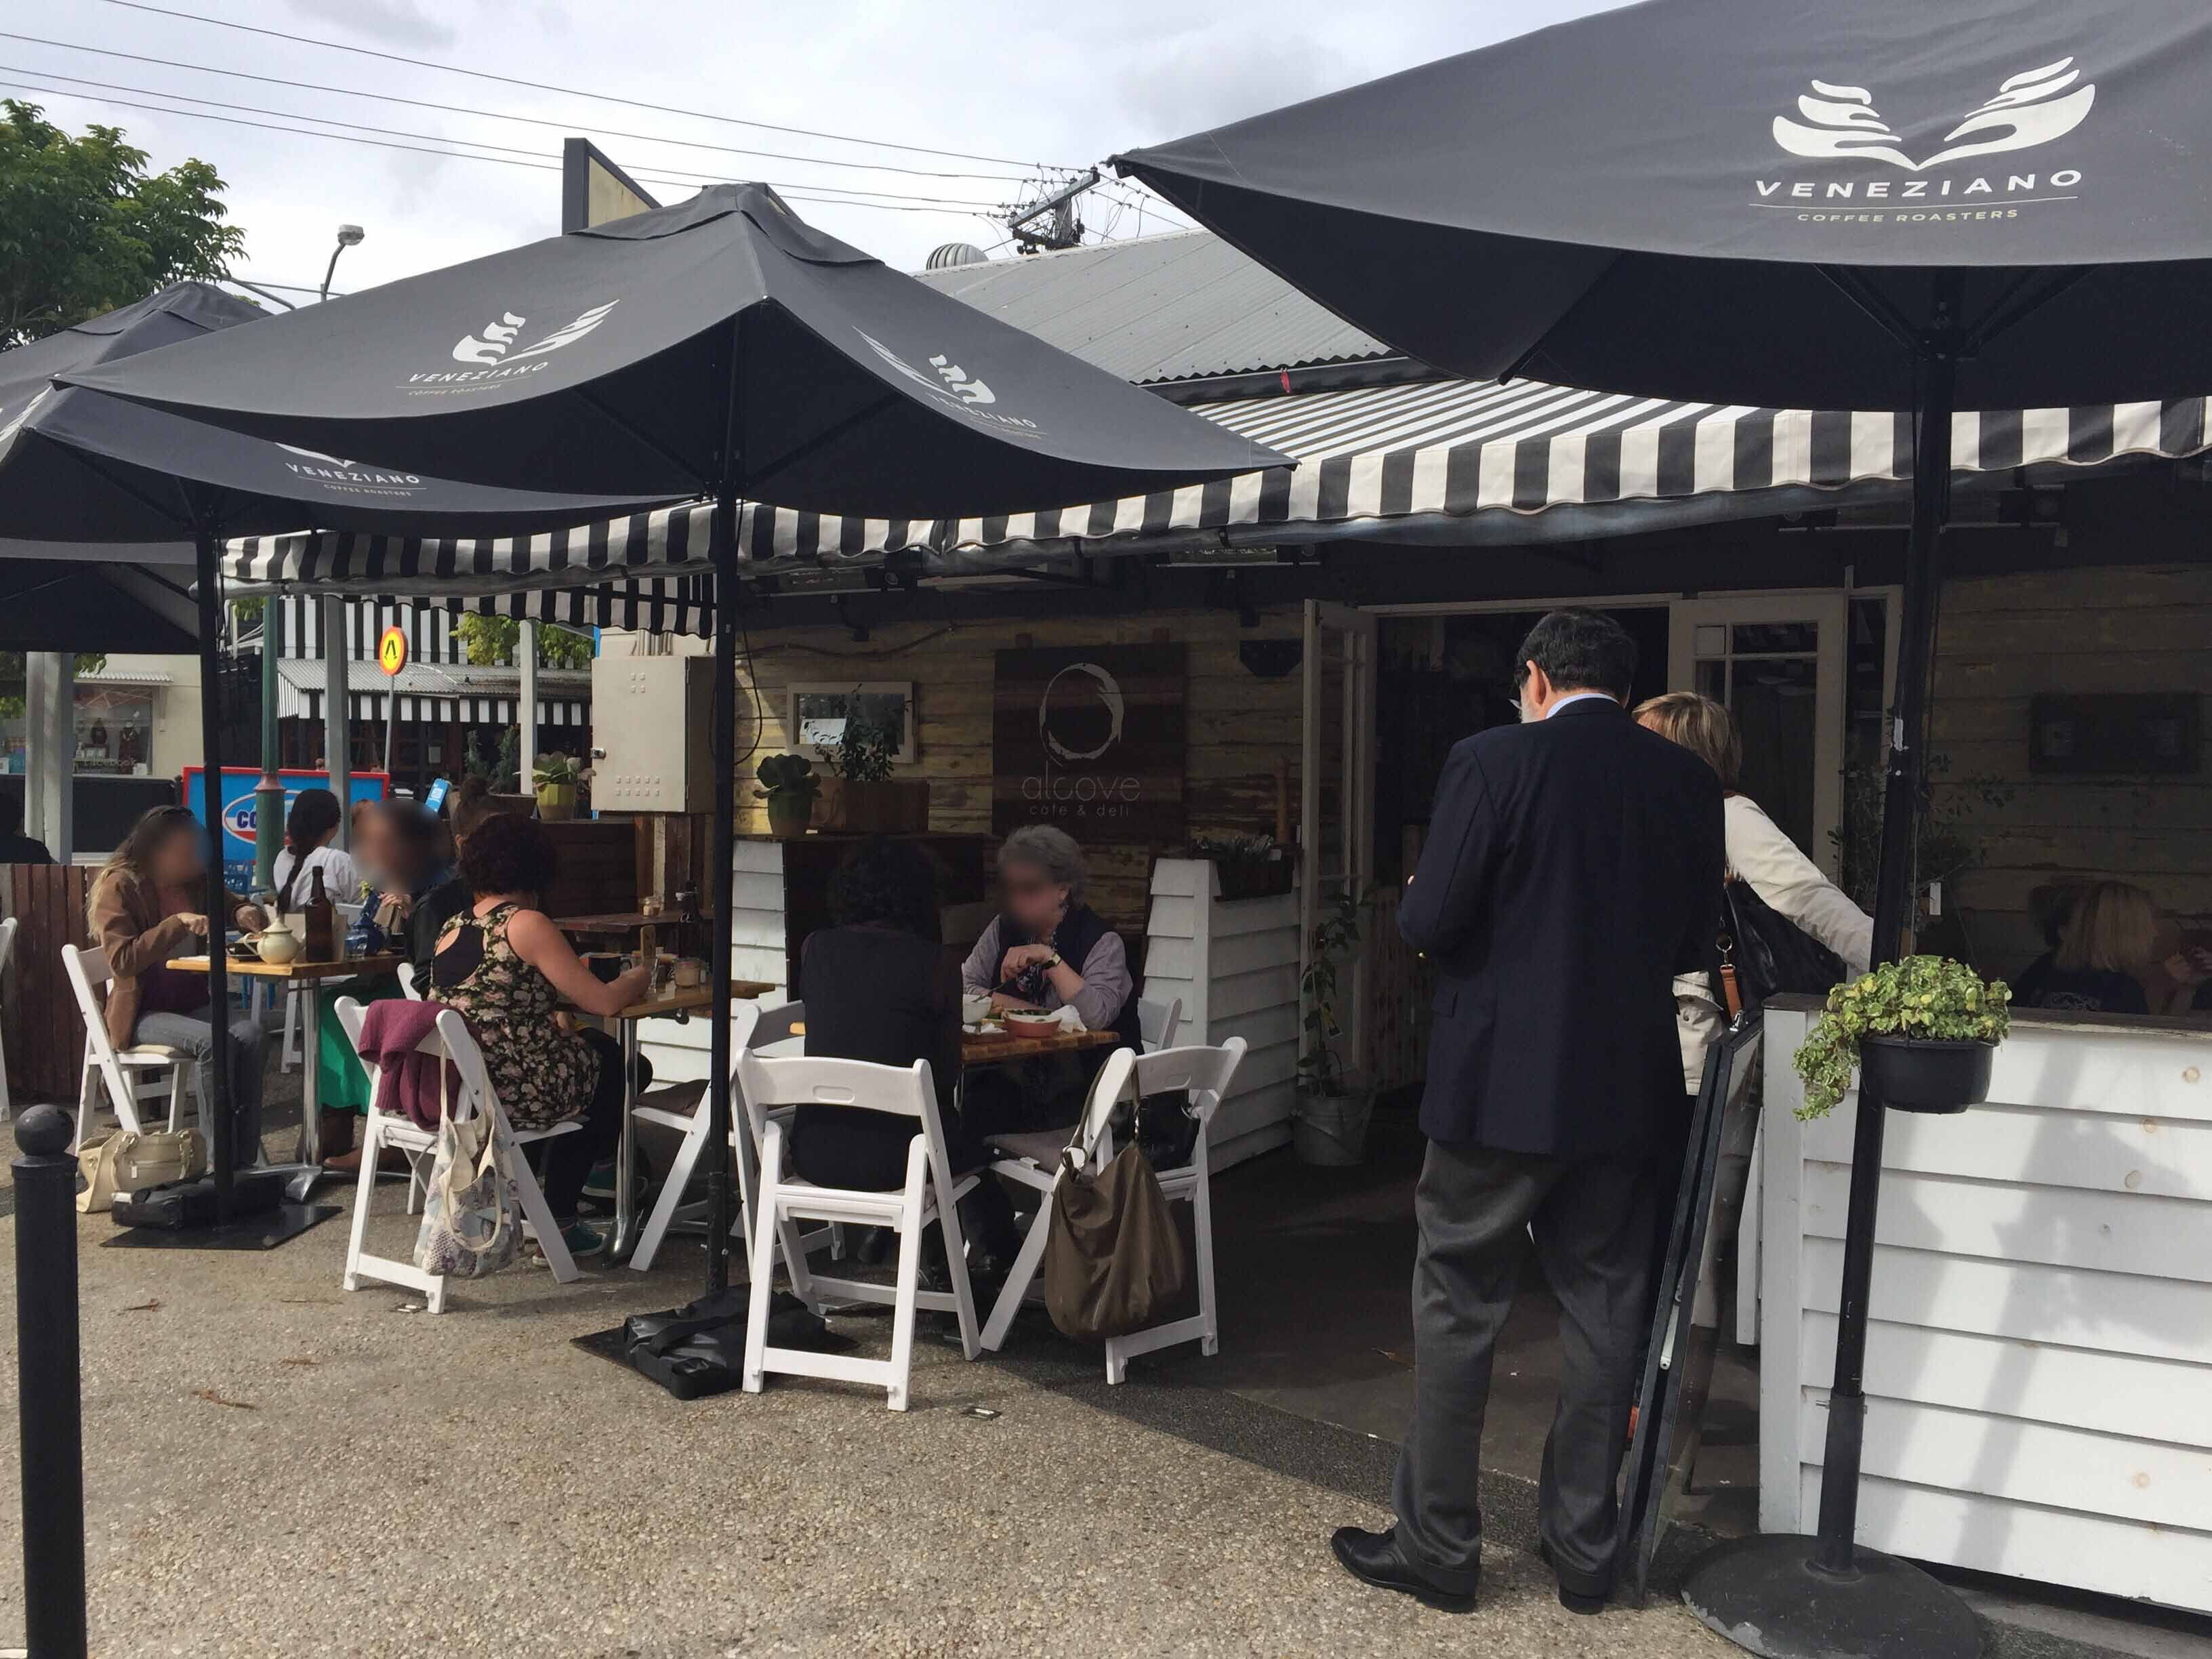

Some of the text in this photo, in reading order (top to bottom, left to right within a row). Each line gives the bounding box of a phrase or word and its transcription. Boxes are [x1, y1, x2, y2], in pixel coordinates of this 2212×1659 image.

[1755, 169, 2083, 198] VENEZIANO
[1797, 209, 2018, 222] COFFEE ROASTERS
[409, 361, 548, 382] VENEZIANO
[285, 462, 421, 485] VENEZIANO
[1021, 760, 1141, 802] alcove
[1078, 804, 1087, 817] &
[1096, 803, 1129, 817] deli
